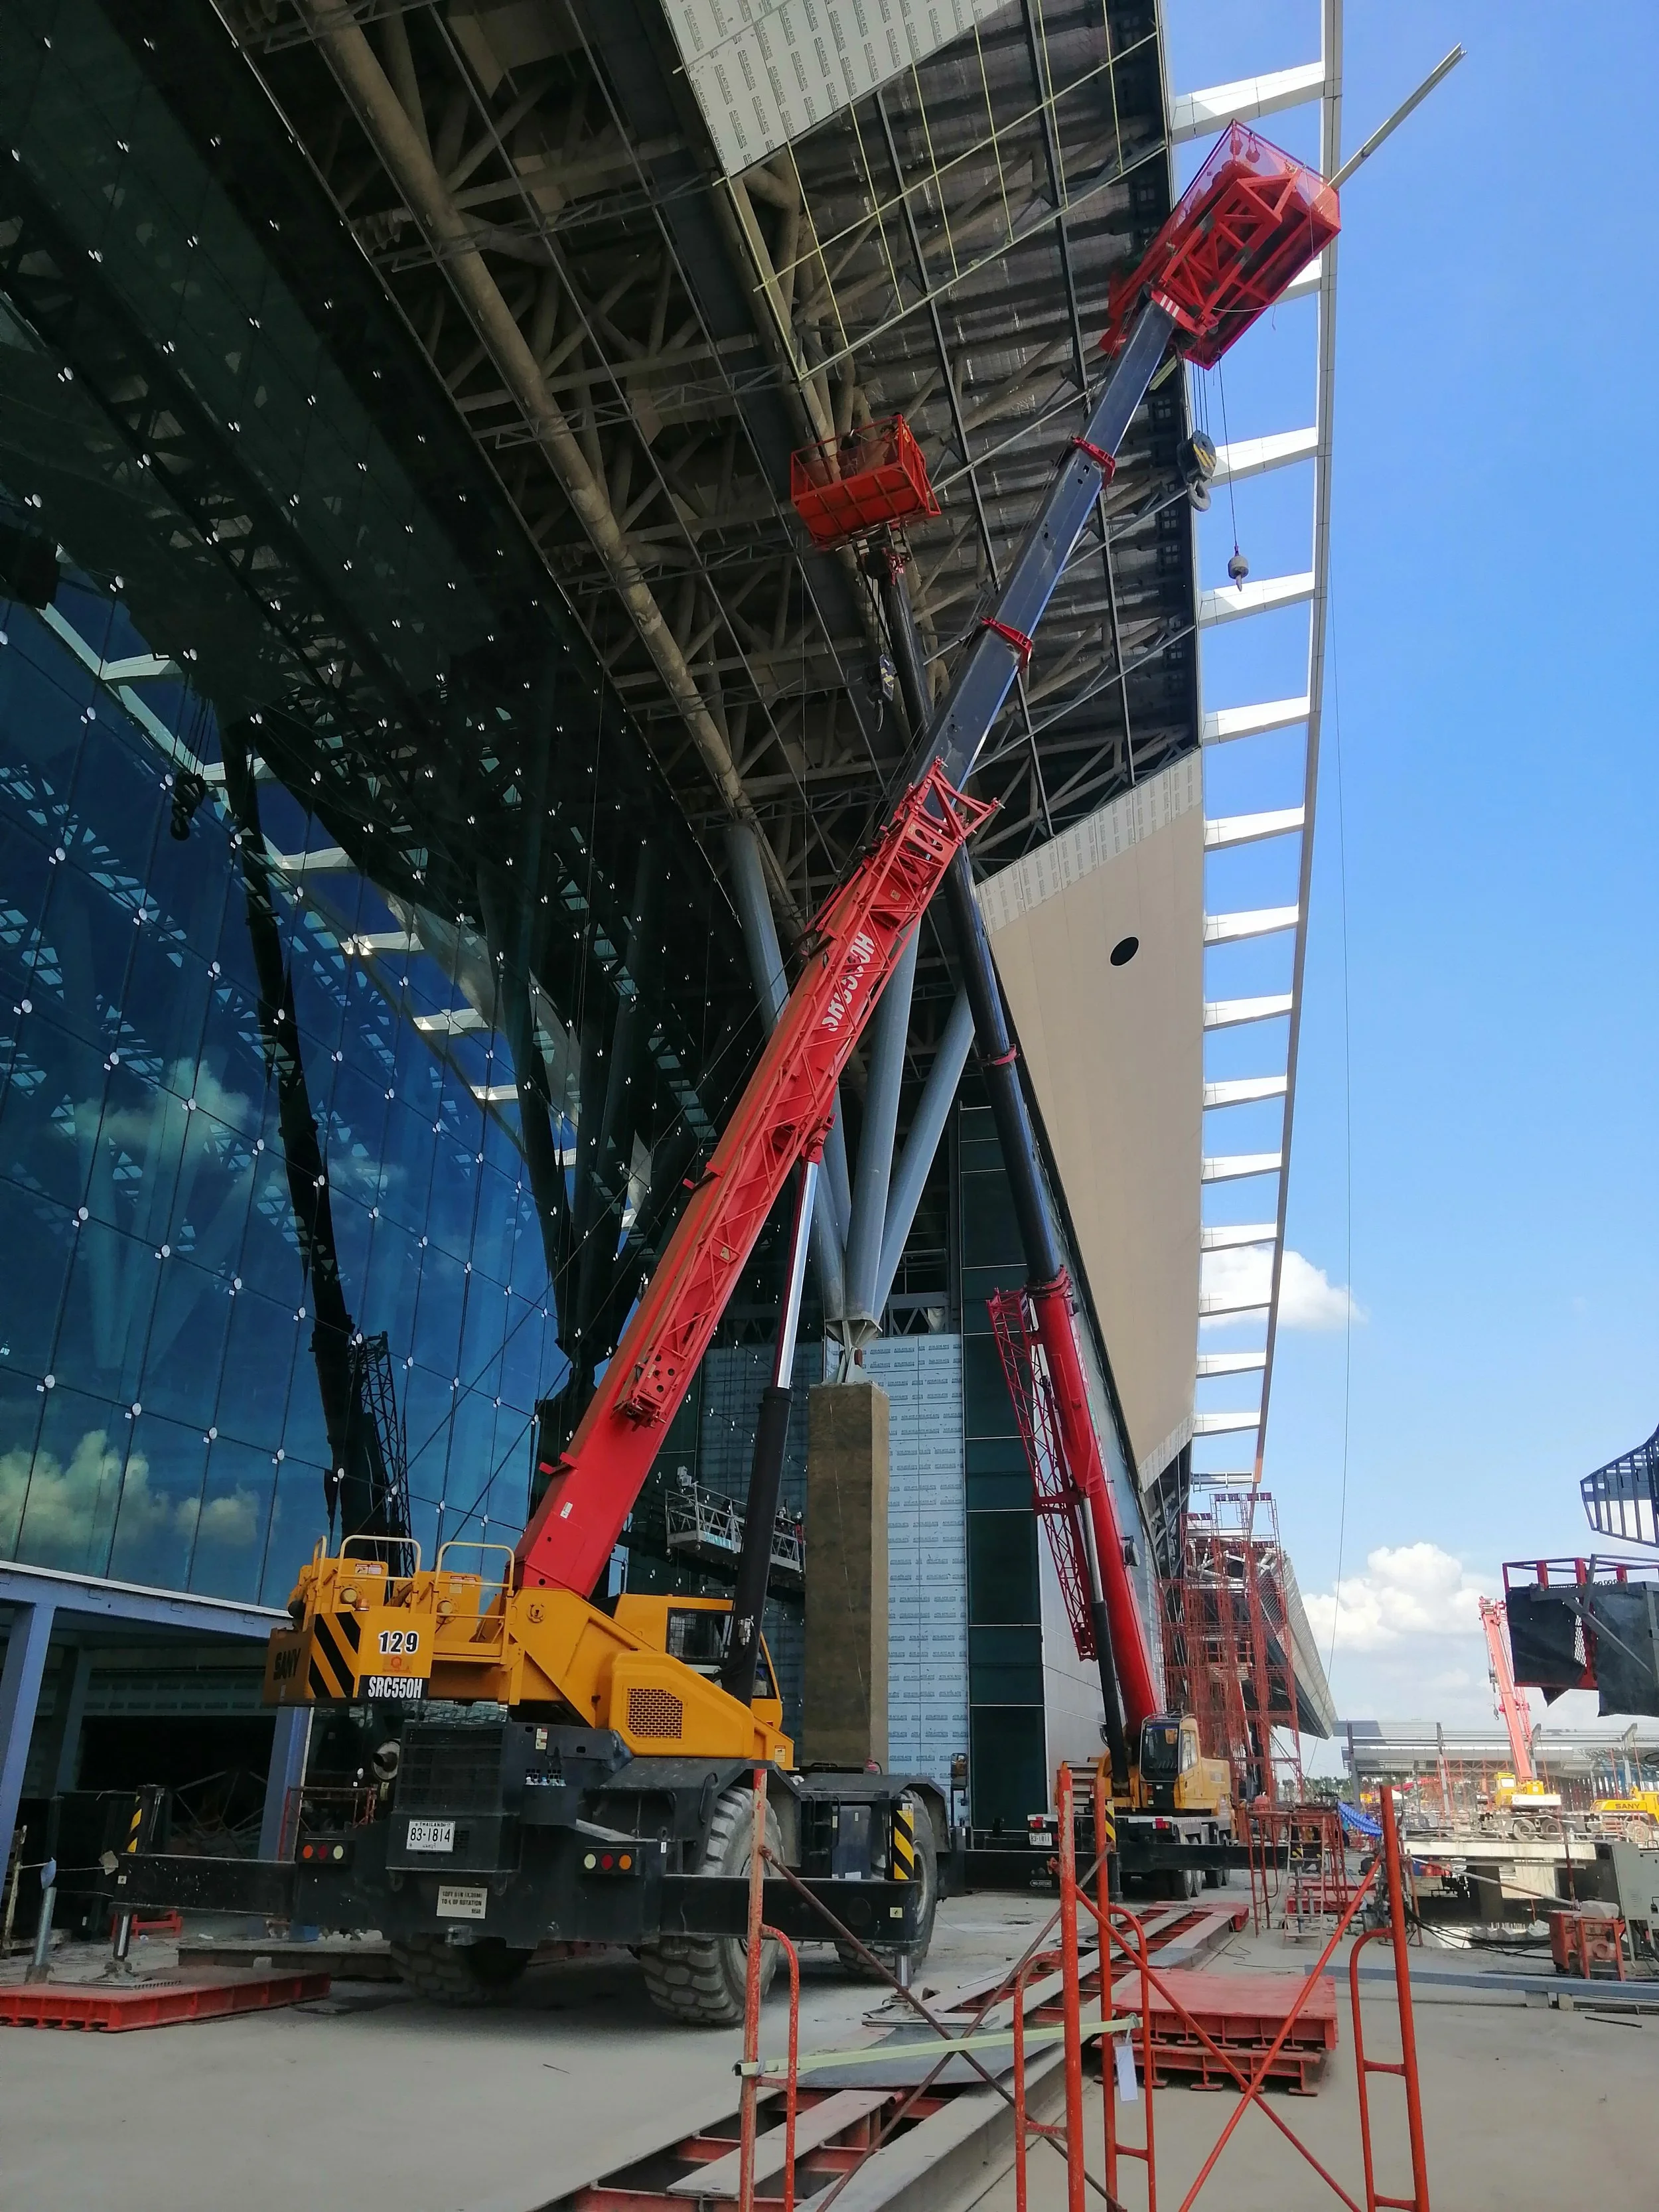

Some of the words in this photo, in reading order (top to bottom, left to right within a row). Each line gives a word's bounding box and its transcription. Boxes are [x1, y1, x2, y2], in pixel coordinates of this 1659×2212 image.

[378, 1630, 419, 1655] 129
[368, 1676, 423, 1699] SRC550H
[410, 1827, 451, 1842] 83-1814
